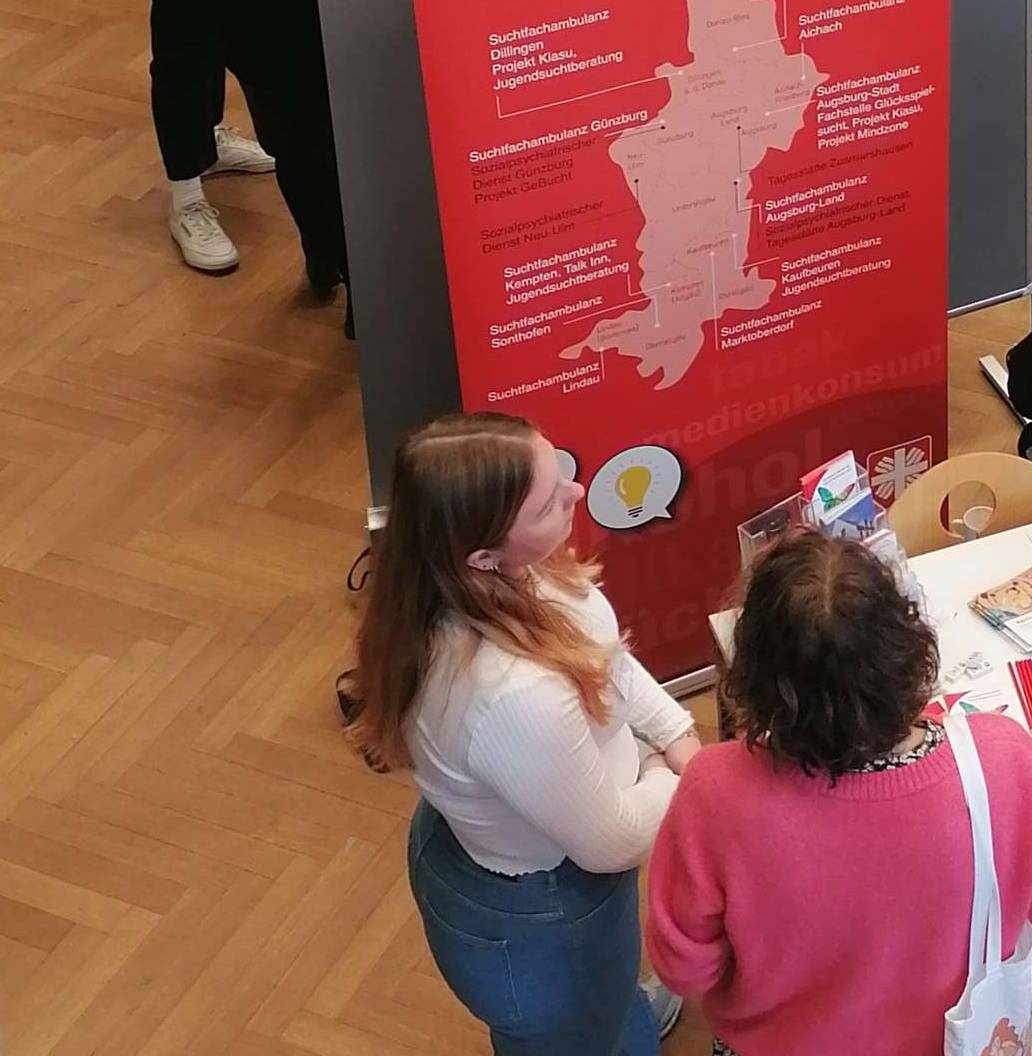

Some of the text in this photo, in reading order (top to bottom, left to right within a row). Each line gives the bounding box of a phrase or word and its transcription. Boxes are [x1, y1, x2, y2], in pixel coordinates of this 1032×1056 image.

[488, 10, 610, 46] Suchtfachambulanz
[799, 21, 843, 41] Aichach
[490, 41, 545, 61] Dillingen
[492, 56, 536, 76] Projekt
[493, 50, 624, 91] Jugendsuchtberatung
[816, 64, 921, 98] Suchtfachambulanz
[816, 82, 901, 112] Augsburg-Stadt
[817, 84, 936, 124] Fachstelle Glücksspiel-
[469, 109, 649, 163] Suchtfachambulanz Günzburg
[817, 120, 850, 138] sucht,
[852, 110, 891, 129] Projekt
[818, 120, 910, 150] Projekt Mindzone
[471, 136, 598, 177] Sozialpsychiatrischer
[473, 157, 575, 192] Dienst Günzburg
[474, 186, 518, 205] Projekt
[765, 174, 869, 211] Suchtfachambulanz
[766, 192, 846, 224] Augsburg-Land
[480, 200, 604, 241] Sozialpsychiatrischer
[766, 189, 911, 237] Sozialpsychiatrischer Dienst
[826, 204, 906, 231] Augsburg-Land
[482, 222, 576, 254] Dienst Neu-Ulm
[780, 236, 883, 273] Suchtfachambulanz
[503, 238, 618, 279] Suchtfachambulanz
[505, 253, 612, 292] Kempten, Talk Inn,
[781, 259, 841, 284] Kaufbeuren
[506, 262, 630, 306] Jugendsuchtberatung
[781, 258, 892, 297] Jugendsuchtberatung
[489, 296, 604, 336] Suchtfachambulanz
[720, 299, 823, 337] Suchtfachambulanz
[491, 325, 551, 349] Sonthofen
[720, 320, 795, 350] Marktoberdorf
[487, 362, 601, 403] Suchtfachambulanz
[562, 374, 601, 393] Lindau
